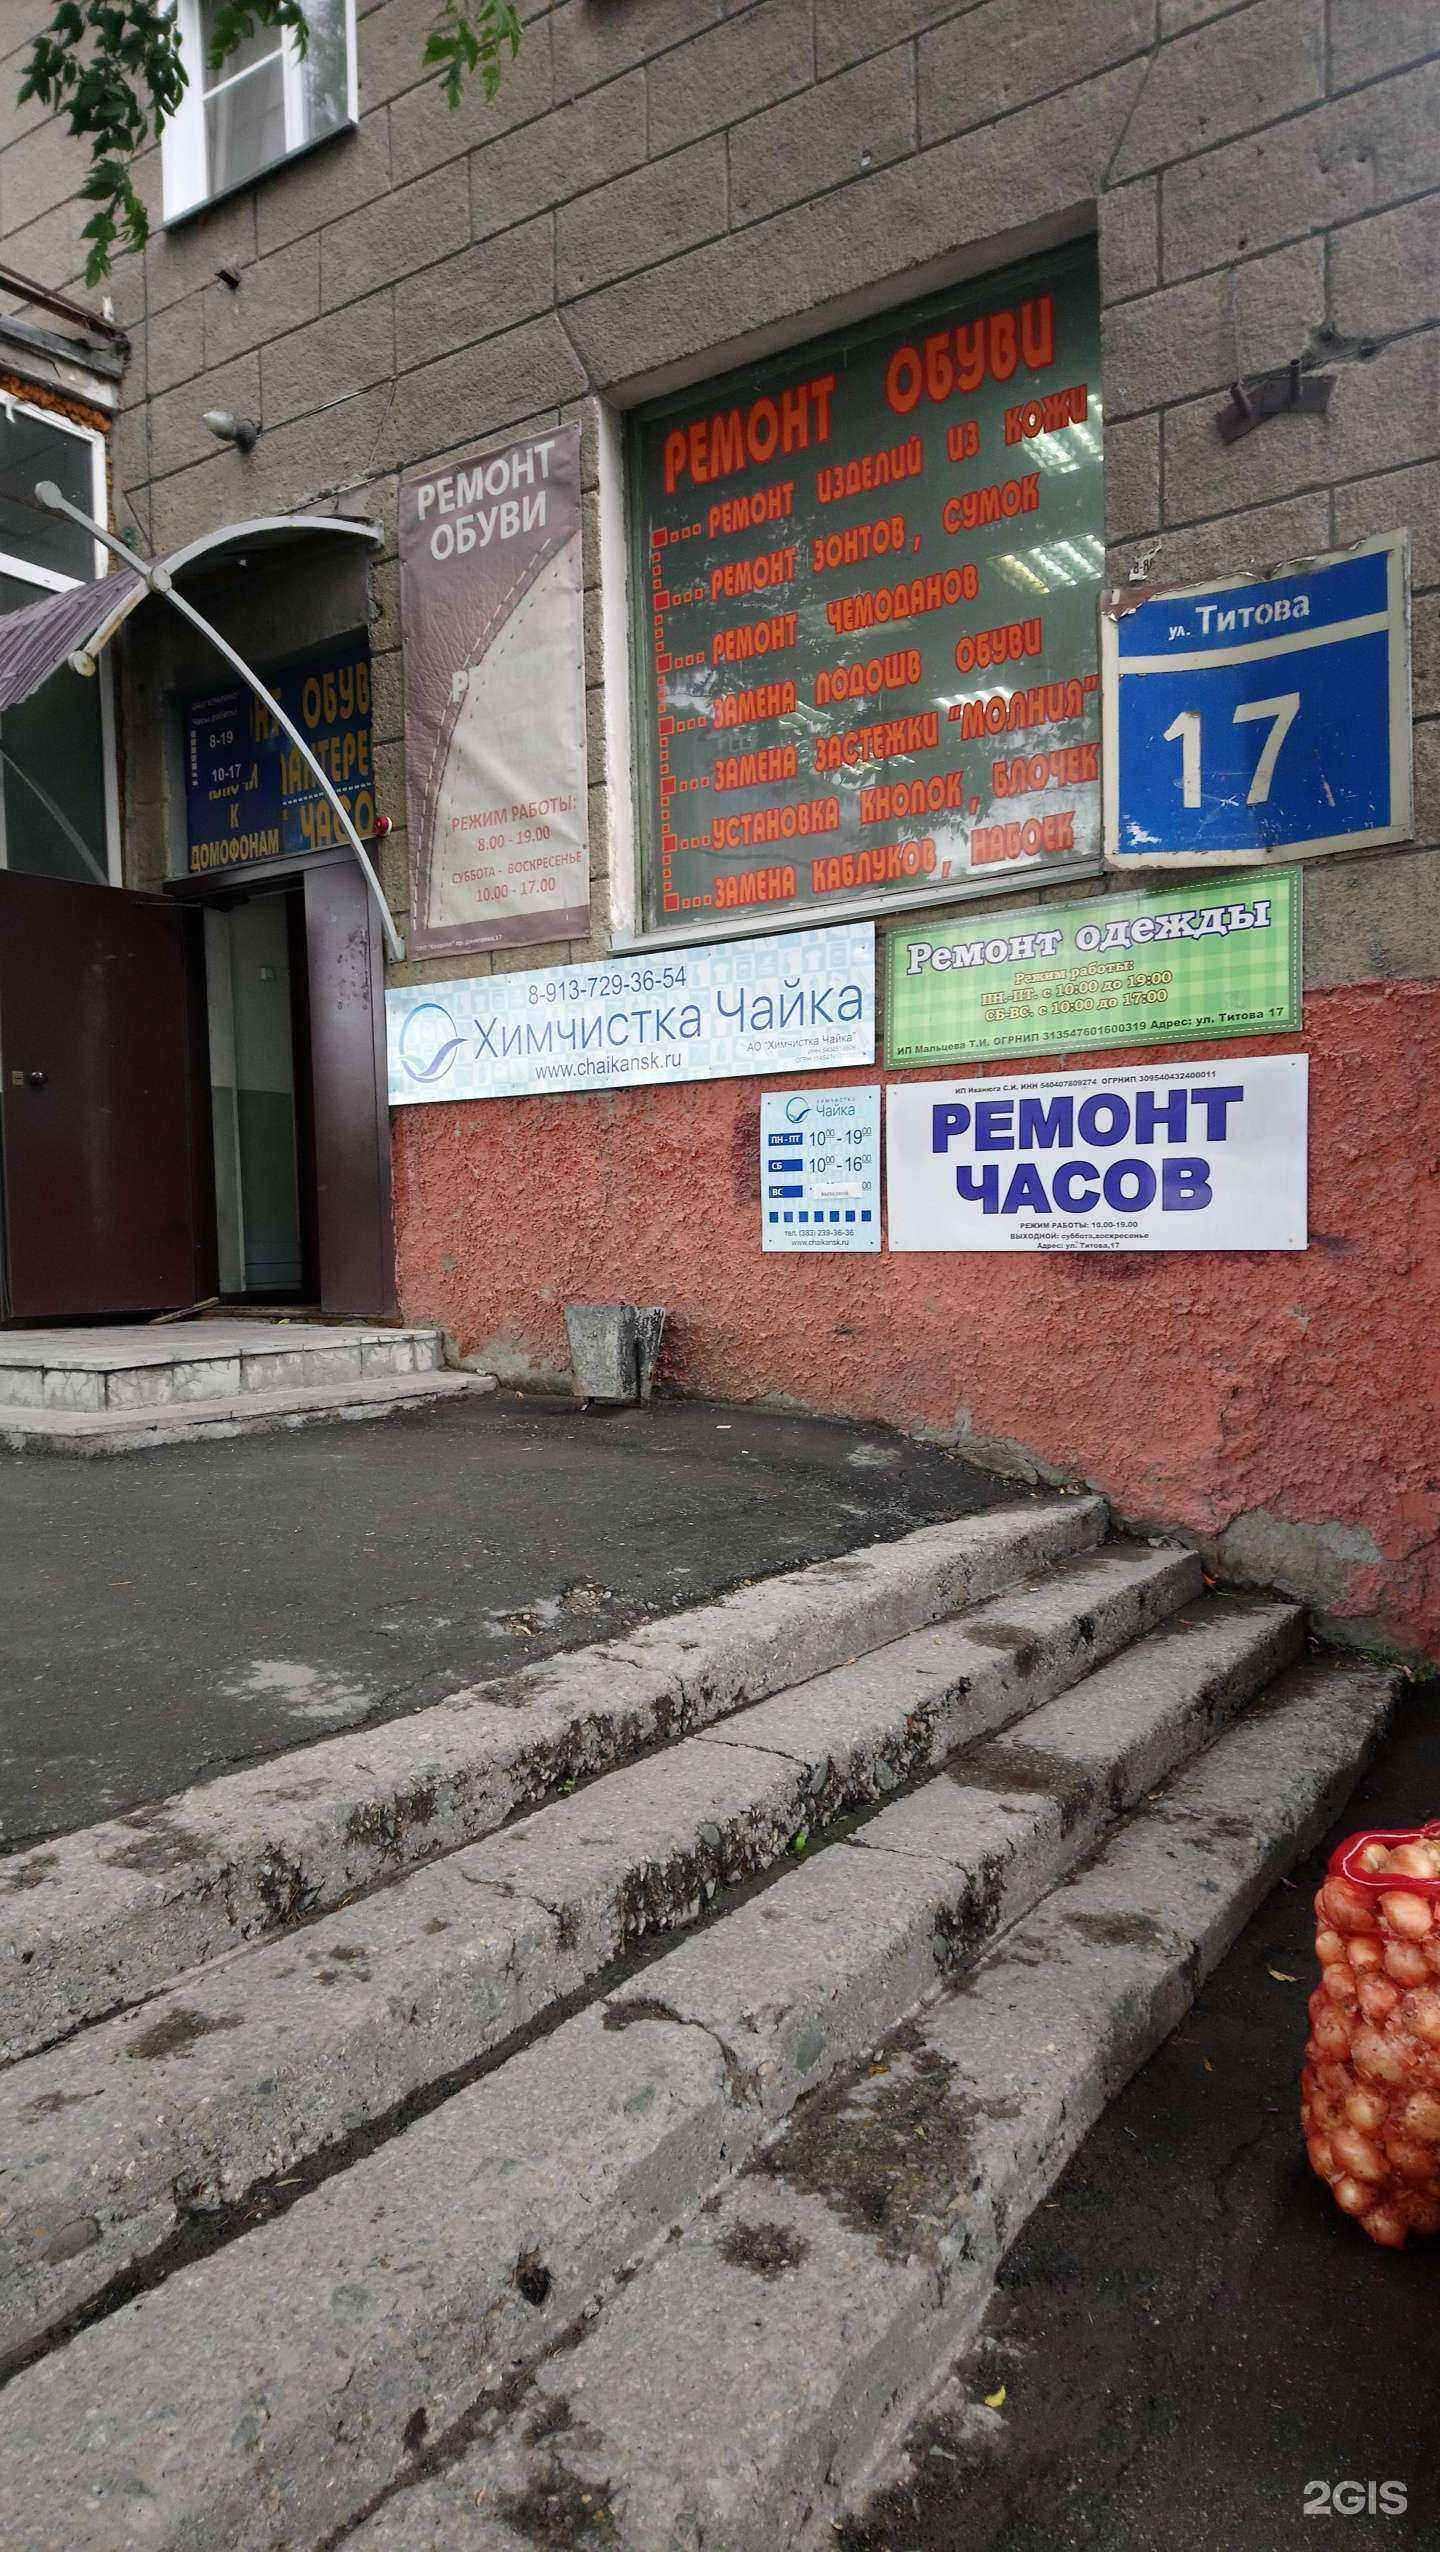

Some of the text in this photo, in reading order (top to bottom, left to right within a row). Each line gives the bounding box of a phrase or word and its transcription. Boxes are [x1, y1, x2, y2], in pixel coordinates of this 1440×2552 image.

[664, 294, 1054, 495] РЕМОНТ ОБУВИ
[418, 441, 555, 520] РЕМОНТ
[708, 384, 1088, 540] РЕМОНТ ИЗДЕЛИЙ ИЗ КОЖИ
[430, 491, 546, 561] ОБУВИ
[711, 543, 796, 600] РЕМОНТ
[942, 471, 1041, 535] СУМОК
[712, 563, 979, 665] РЕМОНТ ЧЕМОДАНОВ
[1168, 593, 1310, 641] ул. Титова
[712, 617, 1042, 730] ЗАМЕНА ПОДОШВ ОБУВИ
[209, 731, 234, 748] 8-19
[713, 675, 1099, 792] ЗАМЕНА ЗАСТЕЖКИ "МОЛНИЯ"
[1163, 691, 1300, 809] 17
[211, 763, 242, 783] 10-17
[452, 794, 577, 832] РЕЖИМ РАБОТЫ:
[711, 796, 839, 850] УСТАНОВКА
[992, 742, 1099, 797] БЛОЧЕК
[229, 803, 239, 828] К
[191, 828, 280, 871] ДОМОФОНАМ
[478, 835, 504, 851] 8.00
[517, 825, 551, 845] 19.00
[452, 867, 495, 884] СУББОТА
[507, 851, 582, 875] ВОСКРЕСЕНЬЕ
[714, 864, 796, 909] ЗАМЕНА
[970, 810, 1075, 866] НАБОЕК
[476, 885, 508, 902] 10.00
[520, 877, 556, 895] 17.00
[907, 900, 1271, 975] Ремонт одежды
[529, 966, 687, 1005] 8-913-729-36-54
[981, 970, 1172, 1006] ПН.-ПТ. с 10:00 до 19:00
[1015, 959, 1134, 985] Режим работы:
[474, 977, 862, 1060] Химчистка Чайка
[1038, 1004, 1047, 1016] с
[1051, 998, 1093, 1015] 10:00
[1098, 997, 1117, 1010] до
[1122, 988, 1168, 1007] 17:00
[746, 1038, 761, 1052] АО
[897, 1046, 912, 1056] ИП
[915, 1041, 966, 1055] Мальцева
[969, 1038, 990, 1049] Т.И.
[994, 1033, 1039, 1046] ОГРНИП
[1151, 1018, 1192, 1031] Адрес:
[1195, 1015, 1214, 1027] ул.
[1219, 1010, 1264, 1023] Титова
[1268, 1007, 1284, 1018] 17
[536, 1052, 682, 1080] www.chaikansk.ru
[1021, 1082, 1038, 1090] ИНН
[1101, 1076, 1136, 1085] ОГРНИП
[816, 1104, 856, 1118] Чайка
[932, 1085, 1244, 1153] РЕМОНТ
[771, 1136, 783, 1144] ПН
[771, 1162, 782, 1170] СБ
[772, 1188, 783, 1196] ВС
[956, 1157, 1213, 1215] ЧАСОВ
[1010, 1232, 1060, 1240] ВЫХОДНОЙ:
[1091, 1221, 1138, 1229] 10.00-19.00
[1037, 1242, 1063, 1250] Адрес:
[1065, 1242, 1077, 1250] ул.
